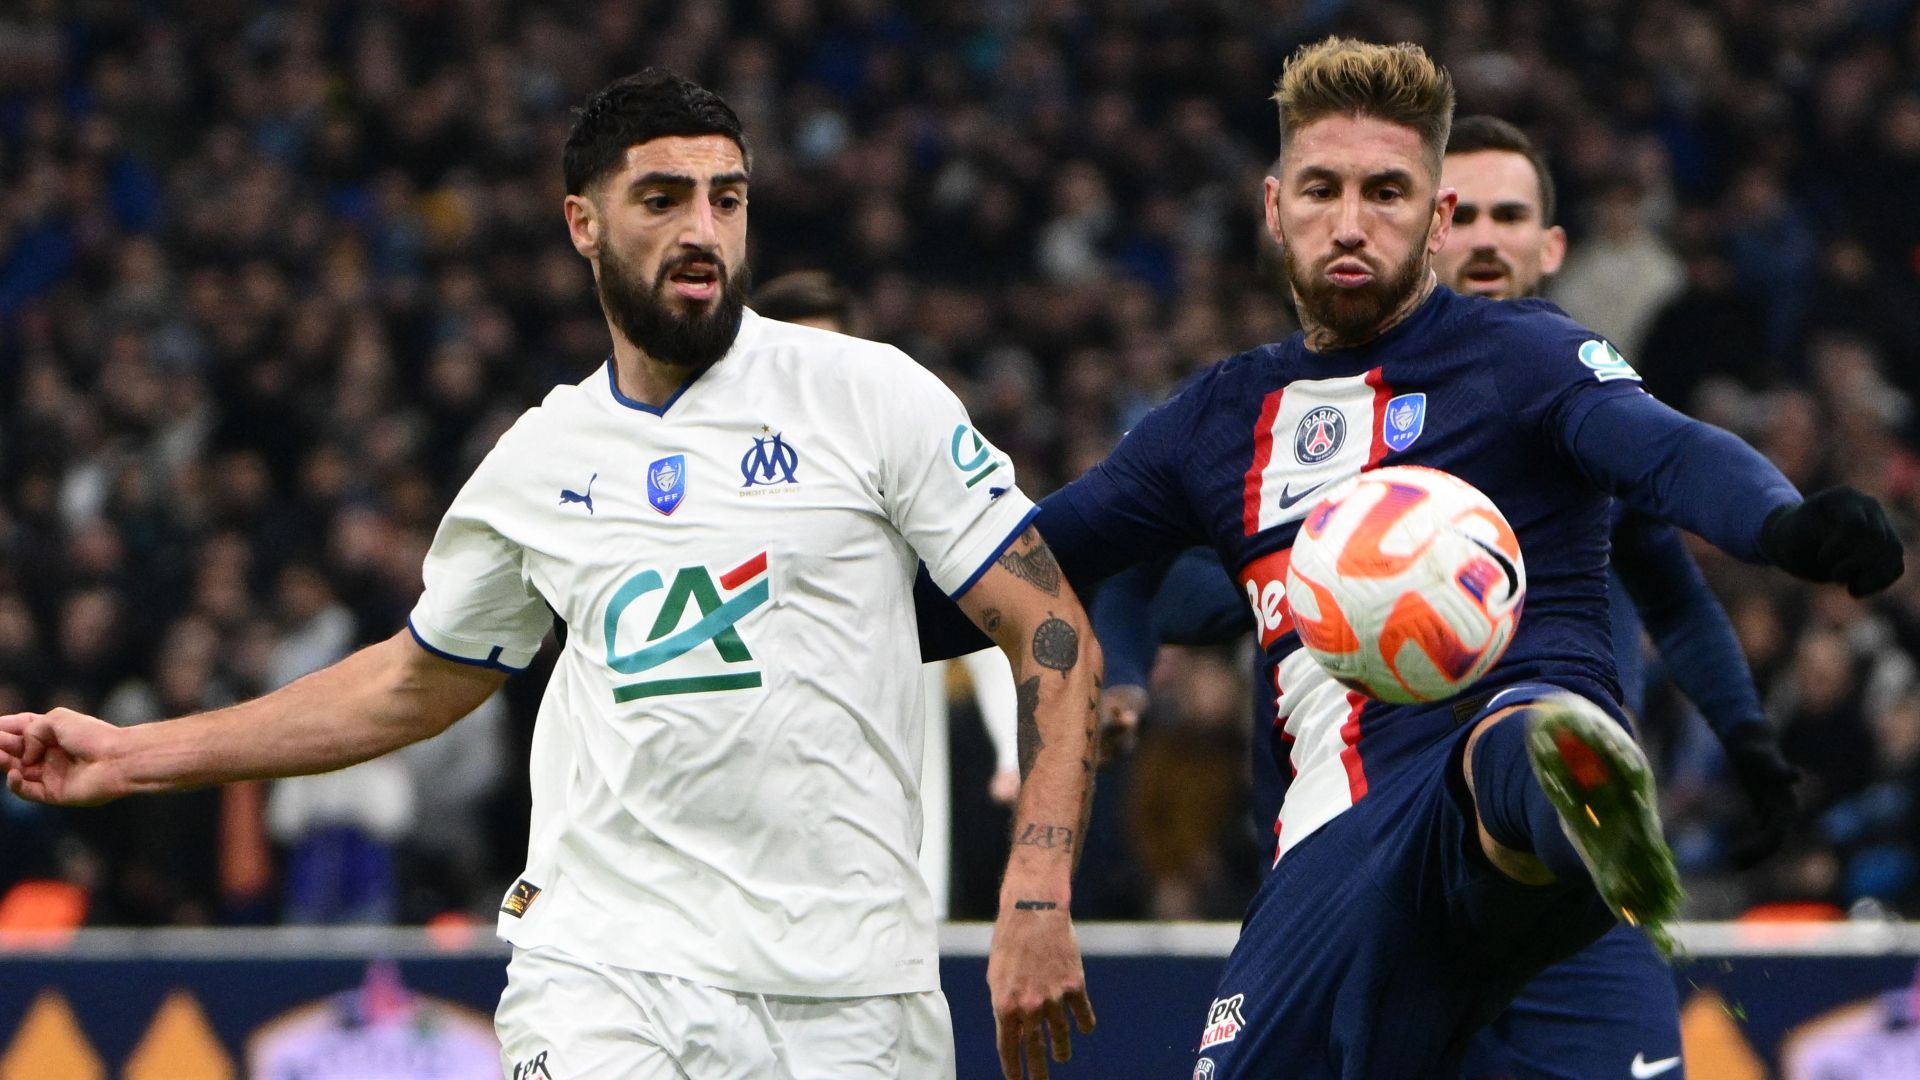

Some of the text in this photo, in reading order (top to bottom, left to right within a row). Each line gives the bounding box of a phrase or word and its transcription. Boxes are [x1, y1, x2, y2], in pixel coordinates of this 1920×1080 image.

[1304, 411, 1338, 429] PARIS
[657, 493, 678, 503] FFF
[604, 565, 769, 675] CA
[1246, 578, 1290, 645] Be
[1206, 996, 1244, 1029] eR
